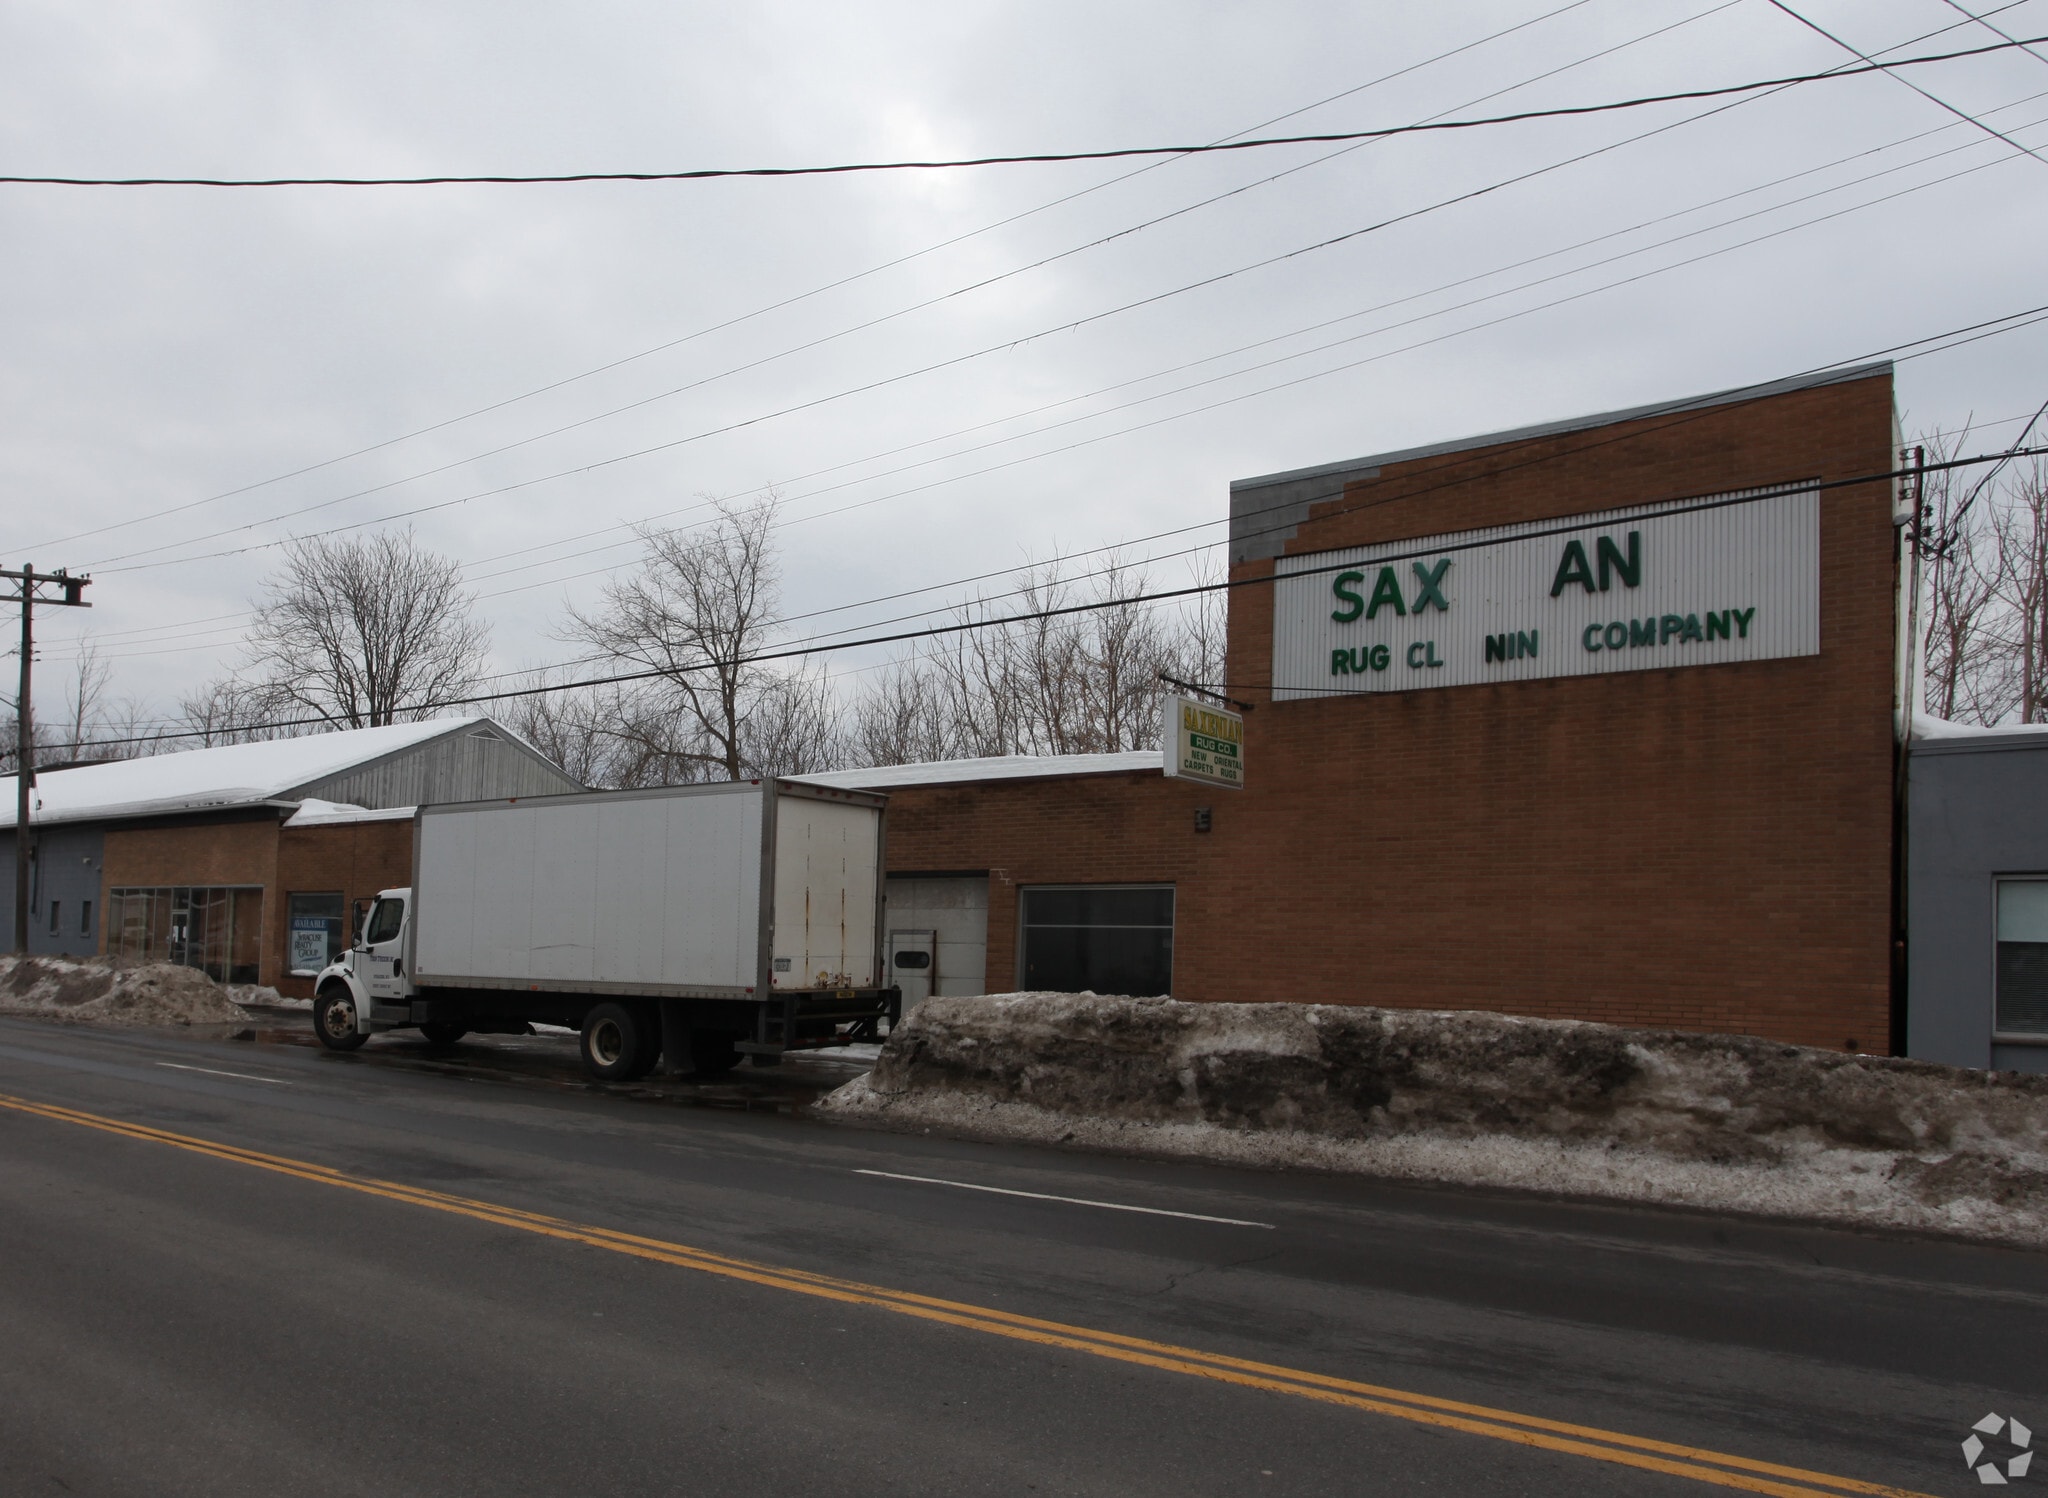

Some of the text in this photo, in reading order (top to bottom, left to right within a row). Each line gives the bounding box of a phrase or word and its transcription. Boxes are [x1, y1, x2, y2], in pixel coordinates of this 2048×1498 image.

[1331, 531, 1641, 623] SAX AN
[1331, 607, 1756, 676] RUG CL NIN COMPANY
[1184, 706, 1242, 745] SAXENIAN
[1196, 737, 1232, 755] RUG CO.
[1191, 750, 1207, 761] NEW
[1214, 756, 1242, 770] ORIENTAL
[1184, 759, 1214, 774] CARPETS
[1220, 767, 1237, 779] RUGS
[294, 919, 327, 929] AVAILABLE
